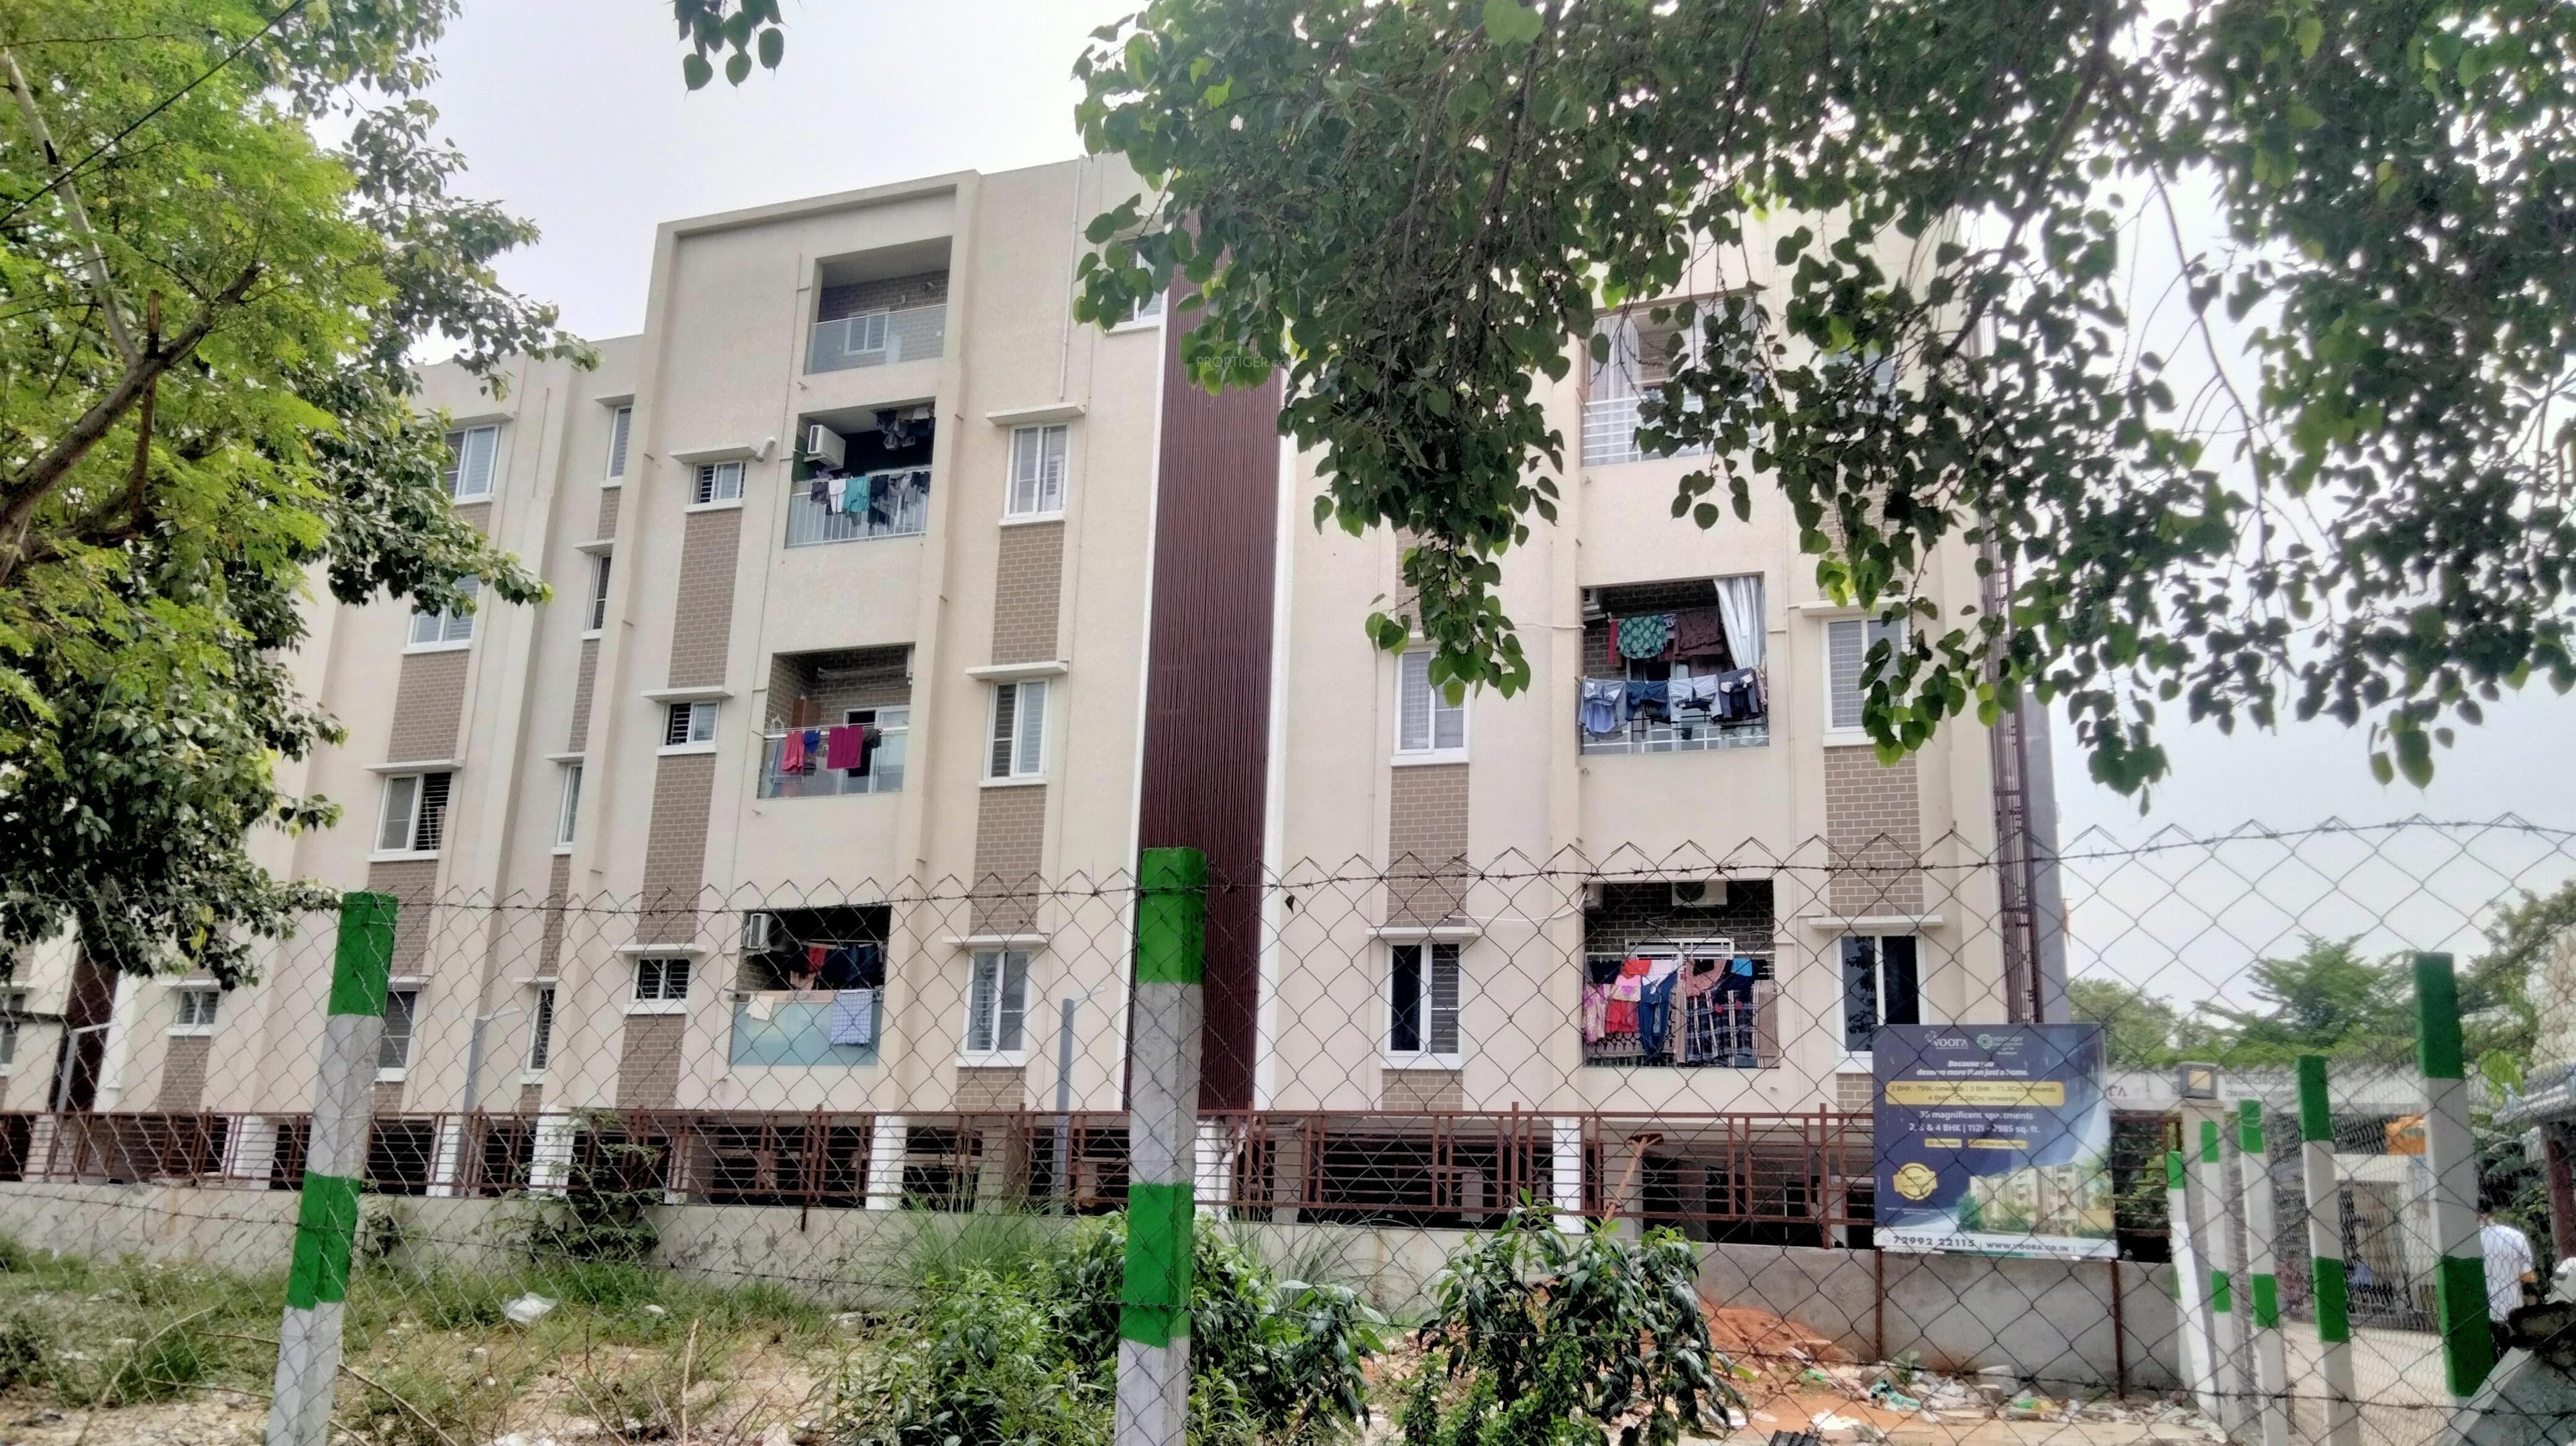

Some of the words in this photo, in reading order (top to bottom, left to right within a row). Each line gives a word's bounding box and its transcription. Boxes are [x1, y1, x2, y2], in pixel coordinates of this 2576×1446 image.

[1984, 1069, 1999, 1077] just
[1932, 1111, 1982, 1121] magnificent
[1927, 1123, 1933, 1131] &
[2015, 1126, 2029, 1134] sq.
[1894, 1236, 1933, 1245] 72992
[1938, 1238, 1975, 1247] 22115
